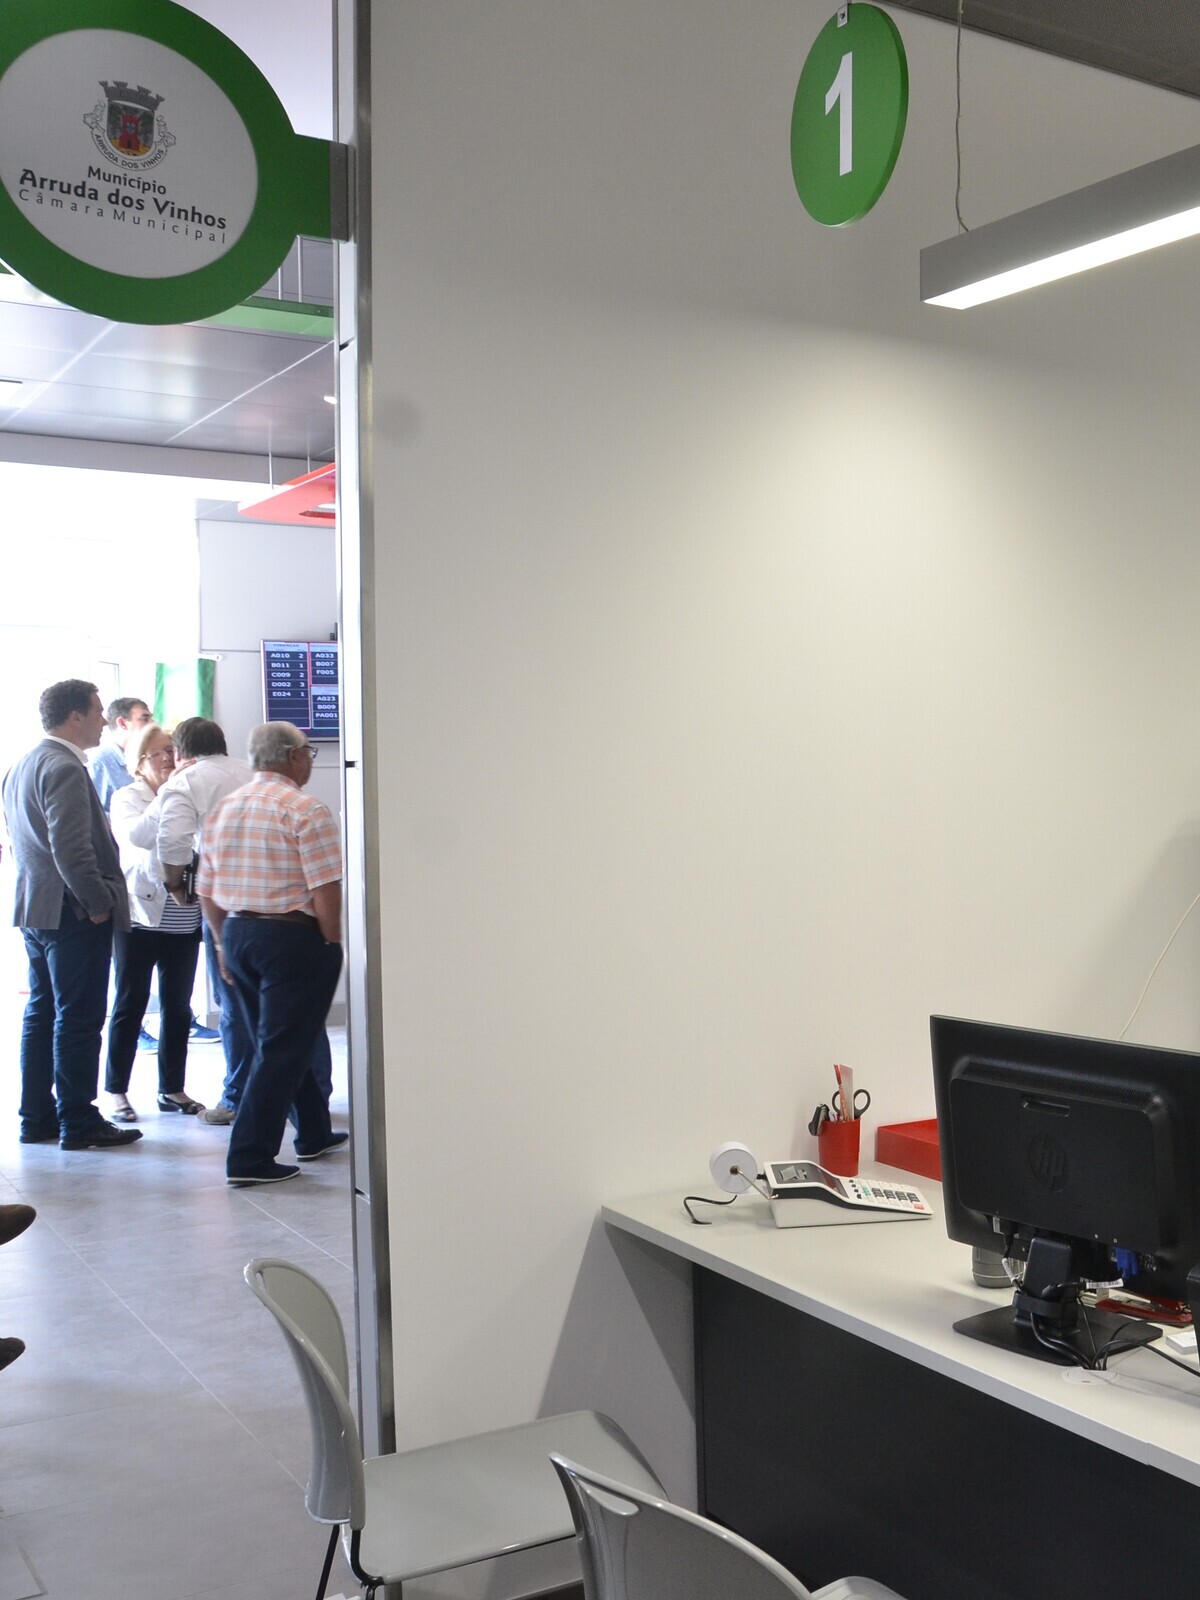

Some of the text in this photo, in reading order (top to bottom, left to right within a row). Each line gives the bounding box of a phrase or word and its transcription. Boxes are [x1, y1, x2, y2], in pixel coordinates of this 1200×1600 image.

[824, 50, 853, 177] 1
[94, 133, 165, 169] ARRUDA DOS VINHOS
[19, 168, 227, 230] Arruda dos Vinhos
[87, 164, 167, 195] Município
